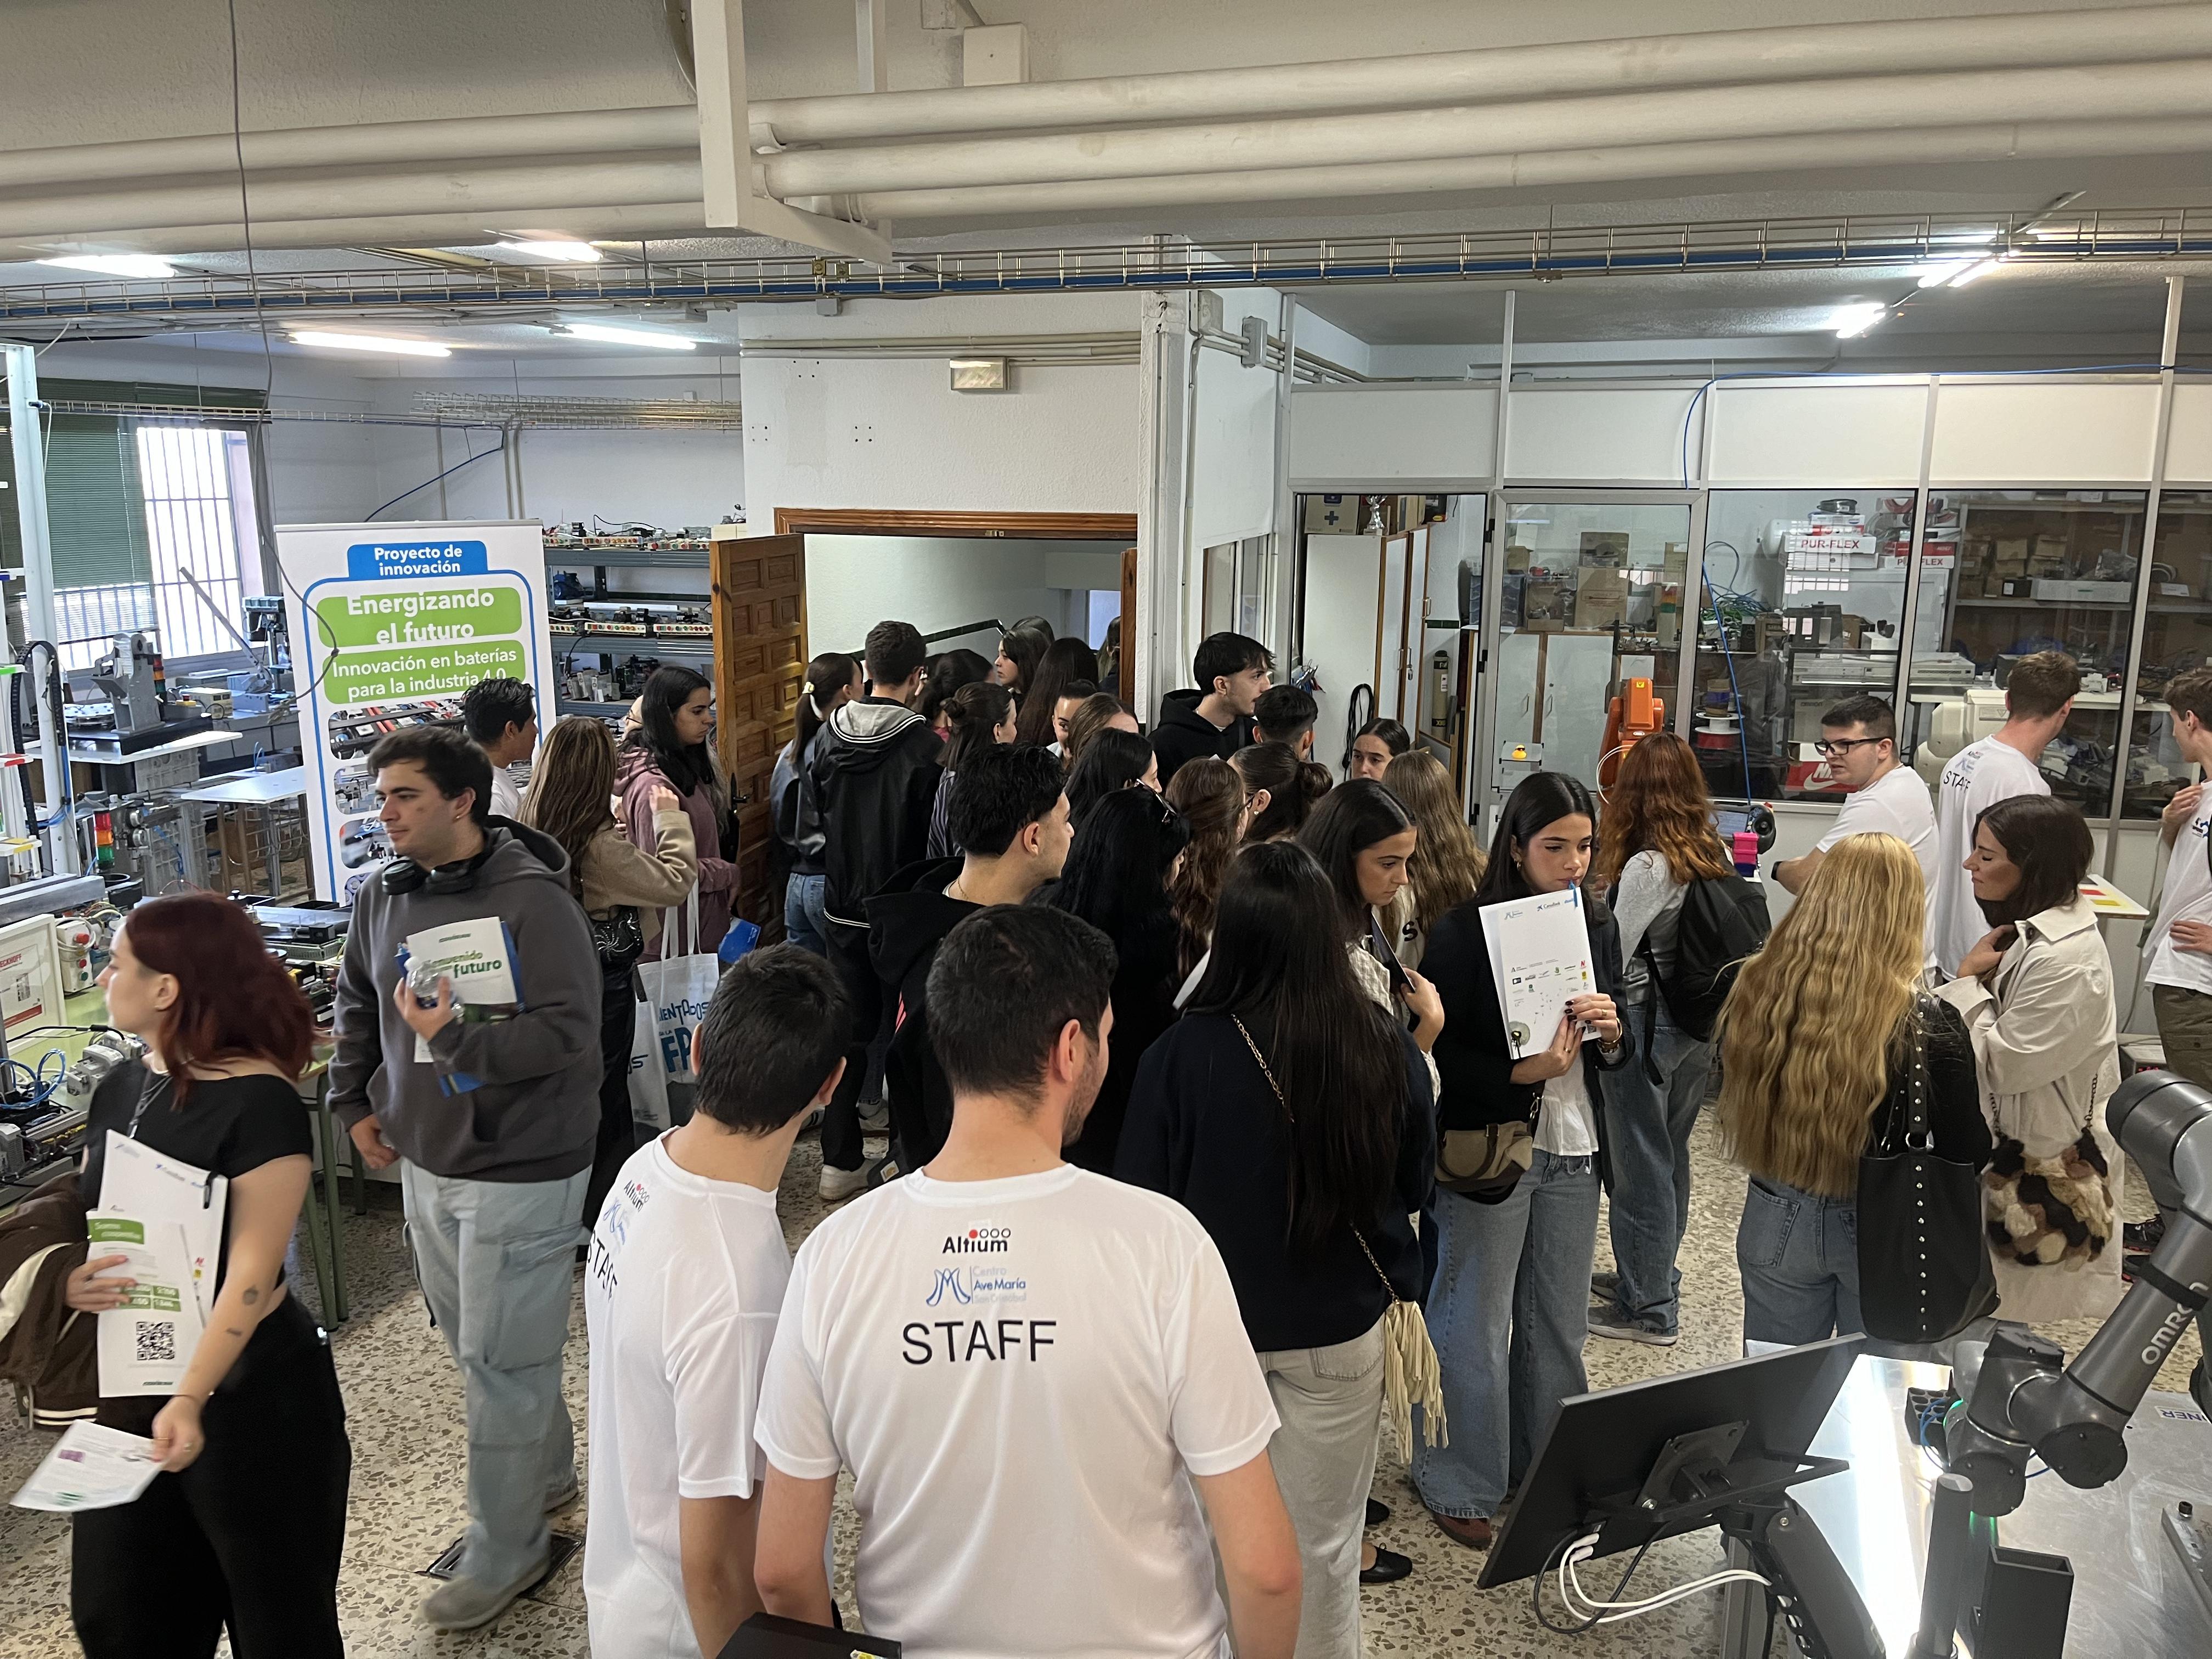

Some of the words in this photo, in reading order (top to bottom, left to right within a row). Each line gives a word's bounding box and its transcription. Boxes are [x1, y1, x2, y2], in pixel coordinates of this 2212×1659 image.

[374, 547, 441, 563] Proyecto
[444, 545, 462, 557] de
[1801, 539, 1860, 549] PUR-FLEX
[379, 560, 461, 576] innovación
[346, 589, 494, 617] Energizando
[376, 623, 397, 645] el
[403, 622, 475, 643] futuro
[333, 656, 426, 678] Innovación
[431, 654, 450, 668] en
[455, 648, 517, 665] baterías
[348, 681, 386, 703] para
[391, 678, 405, 693] la
[410, 672, 479, 691] industria
[482, 667, 507, 681] 40
[453, 960, 503, 979] futuro
[659, 999, 709, 1025] IENTADOS
[661, 1026, 692, 1073] FP
[942, 1235, 1008, 1254] Altium
[973, 1265, 1007, 1277] Centro
[973, 1279, 993, 1291] Ave
[994, 1277, 1026, 1290] María
[902, 1319, 1057, 1365] STAFF
